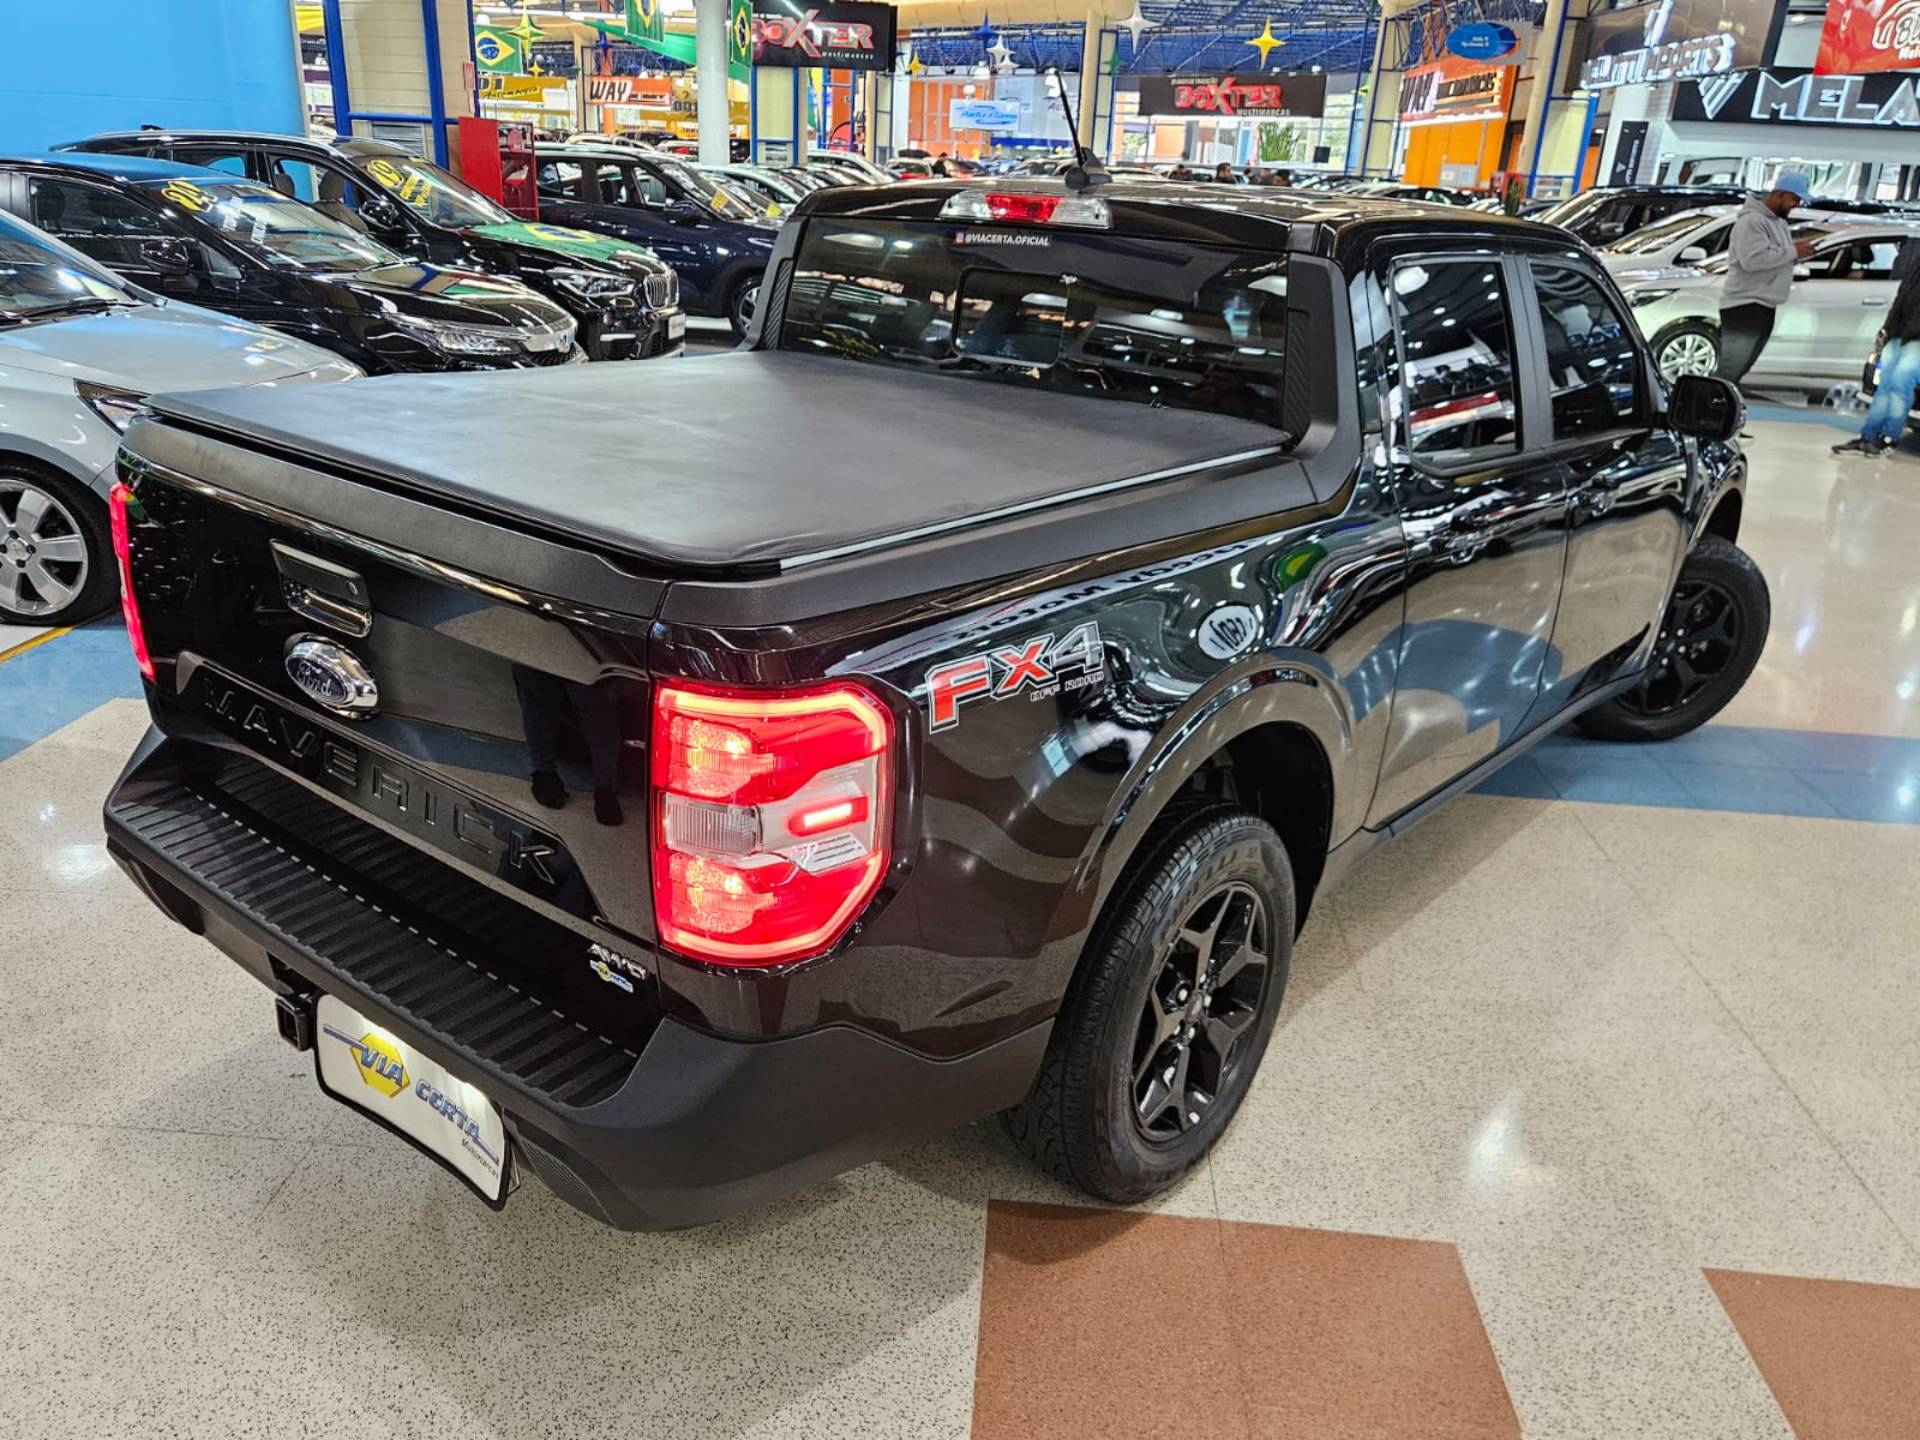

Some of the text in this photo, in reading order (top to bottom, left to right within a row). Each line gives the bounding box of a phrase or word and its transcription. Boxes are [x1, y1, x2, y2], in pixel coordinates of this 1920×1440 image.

[590, 81, 628, 100] WAY
[1175, 76, 1283, 115] BOXTER
[1750, 71, 1920, 127] MELA
[965, 232, 1050, 247] @VIACERTA.OFICIAL
[297, 659, 332, 697] Ford
[924, 621, 1104, 735] FX4
[1065, 671, 1105, 692] ROAD
[202, 676, 557, 886] MAVERICK
[360, 1047, 404, 1088] VIA
